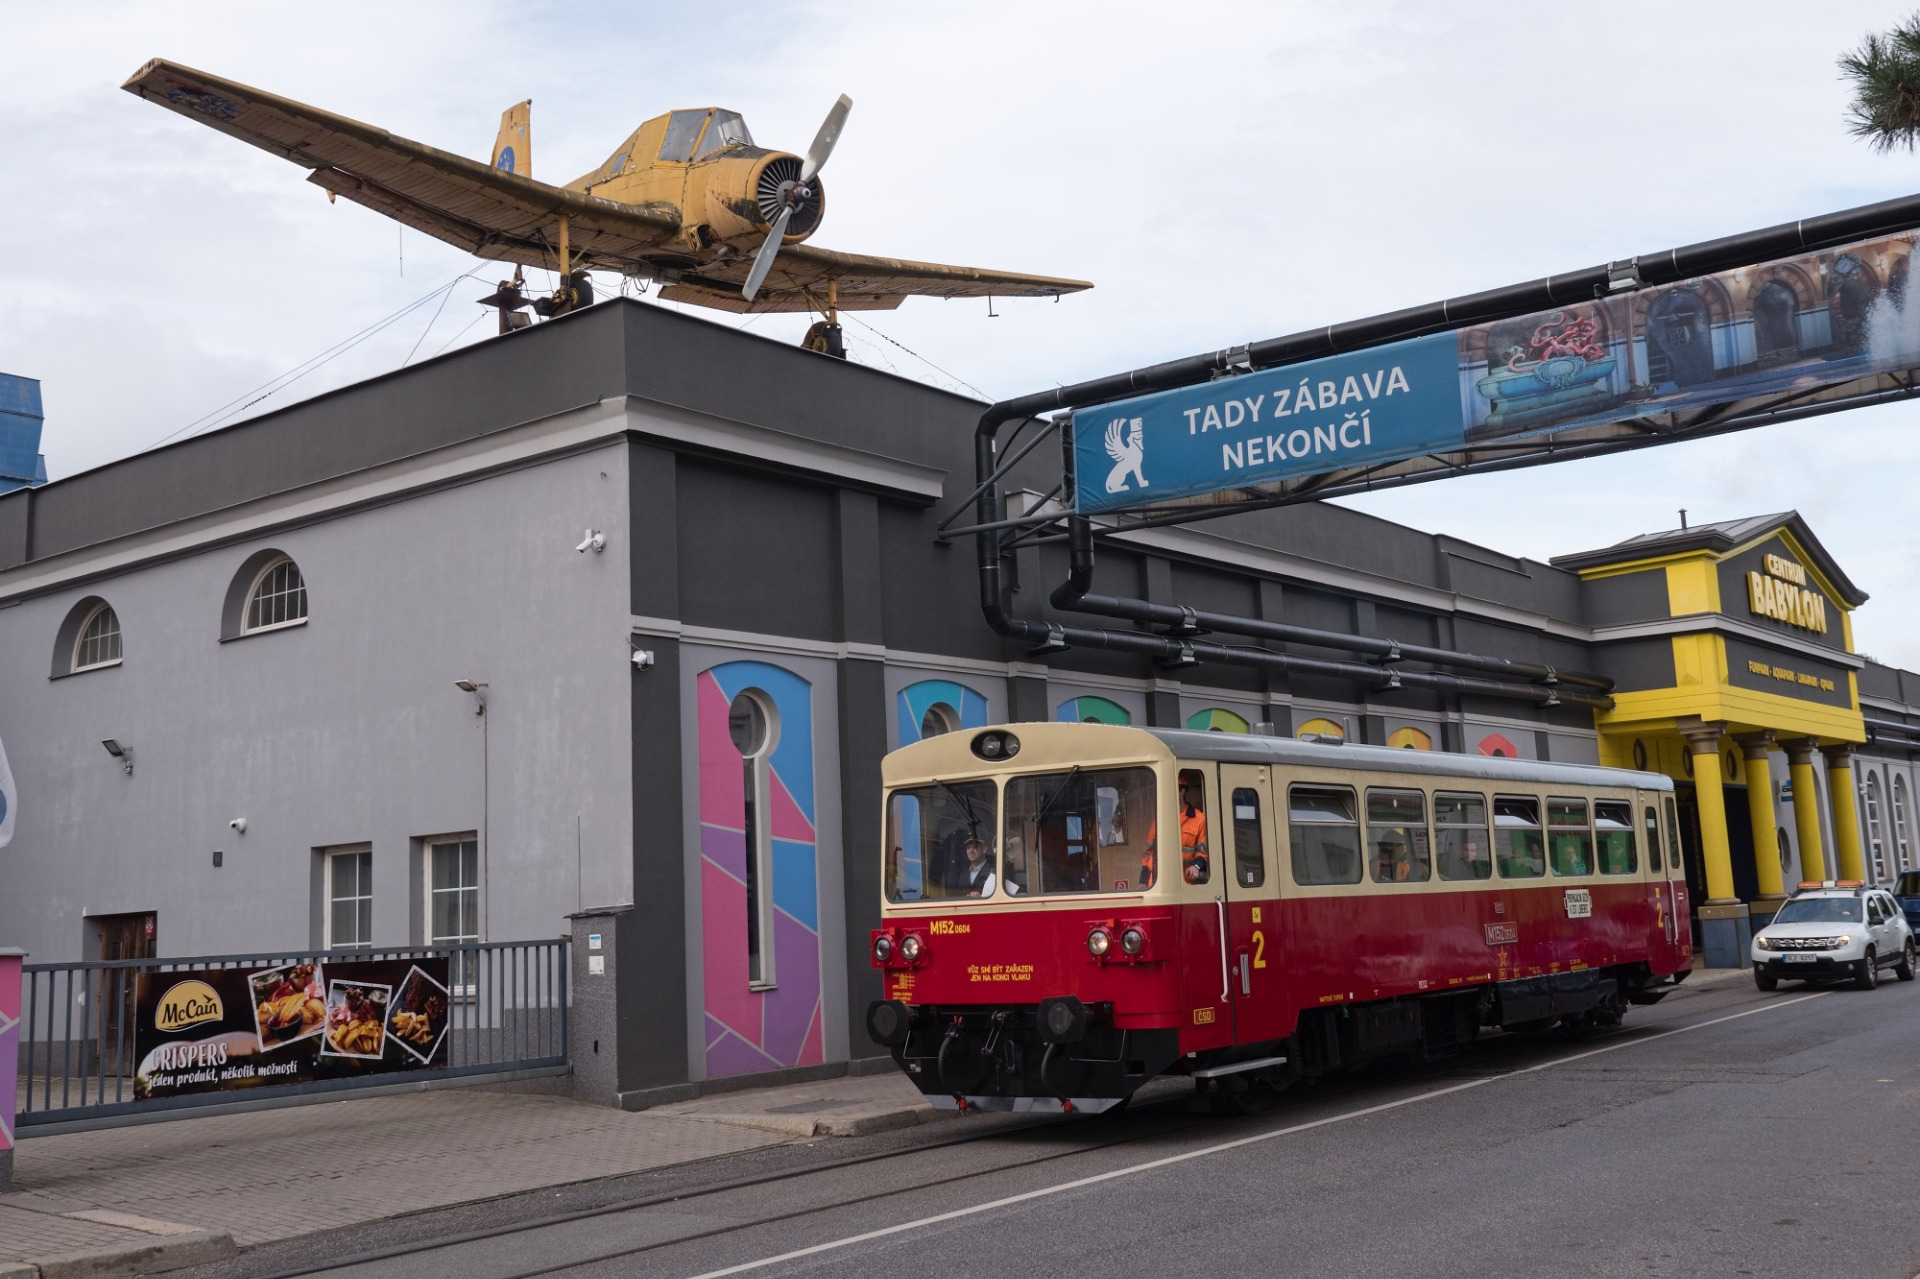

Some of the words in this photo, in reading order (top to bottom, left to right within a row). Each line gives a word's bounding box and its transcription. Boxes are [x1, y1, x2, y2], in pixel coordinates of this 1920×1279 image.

[1183, 394, 1265, 435] TADY
[1273, 366, 1411, 419] ZÁBAVA
[1222, 408, 1371, 471] NEKONČÍ
[1763, 553, 1806, 587] CENTRUM
[1747, 571, 1827, 634] BABYLON
[1748, 660, 1770, 676] FUNPARK
[1772, 666, 1795, 682] AQUAPARK
[1796, 672, 1818, 688] LUNAPARK
[930, 920, 954, 934] M152
[1656, 902, 1664, 928] 2
[1487, 925, 1505, 942] M152
[1252, 930, 1266, 969] 2
[967, 964, 979, 974] VŮZ
[980, 964, 991, 974] SMÍ
[992, 964, 1003, 973] BÝT
[1005, 963, 1034, 973] ZAŘAZEN
[970, 974, 981, 982] JEN
[982, 974, 991, 982] NA
[1011, 973, 1031, 981] VLAKU
[161, 999, 218, 1025] McCain
[1198, 1010, 1212, 1022] ČSD
[151, 1042, 228, 1072] CRISPERS
[148, 1073, 174, 1089] jeden
[176, 1067, 219, 1088] produkt,
[221, 1063, 256, 1080] několik
[258, 1060, 298, 1077] možností
